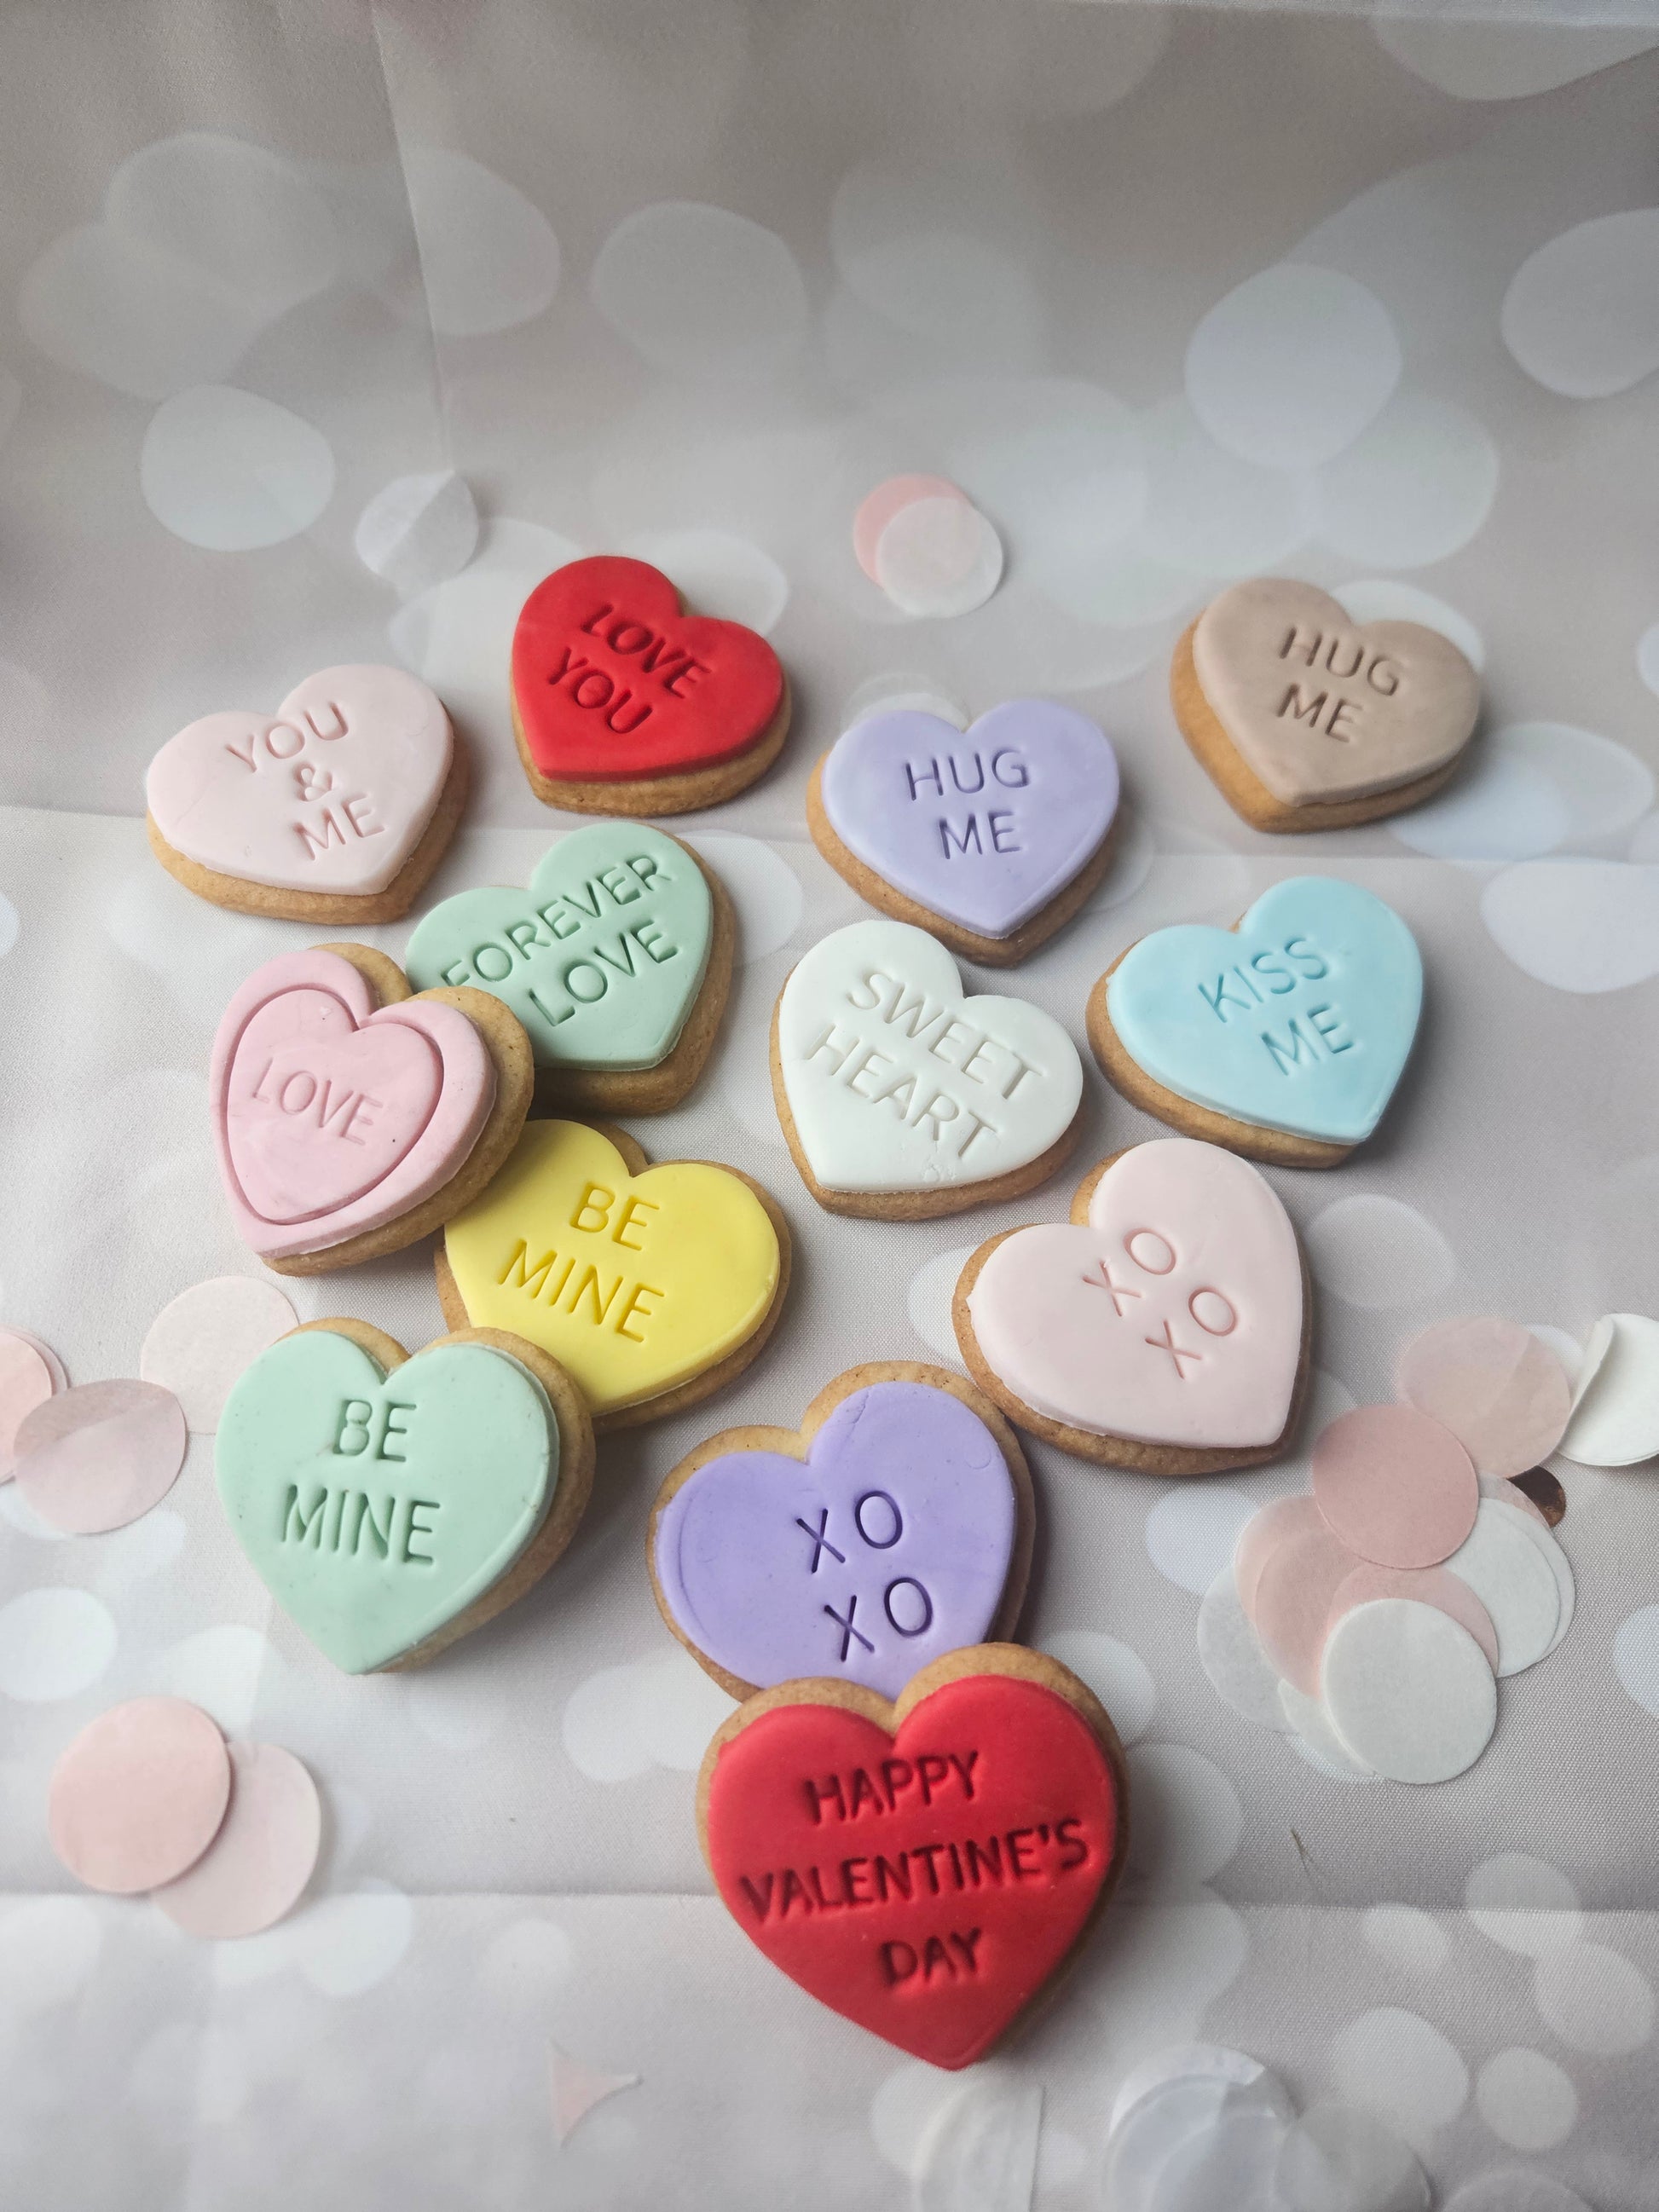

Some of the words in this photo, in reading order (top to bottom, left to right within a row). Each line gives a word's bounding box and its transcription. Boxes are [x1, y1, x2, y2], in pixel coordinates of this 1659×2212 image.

[581, 604, 711, 699] LOVE
[1279, 627, 1402, 697] HUG
[547, 648, 652, 735] YOU
[1276, 684, 1363, 744] ME
[225, 701, 350, 773] YOU
[905, 748, 1032, 801] HUG
[294, 761, 333, 803] &
[292, 792, 386, 861] ME
[938, 810, 1024, 859] ME
[528, 921, 679, 1027] LOVE
[1196, 937, 1332, 1023] KISS
[847, 970, 1046, 1102] SWEET
[1258, 1002, 1357, 1077] ME
[251, 1057, 384, 1146] LOVE
[806, 1025, 1003, 1158] HEART
[569, 1181, 661, 1251] BE
[498, 1239, 666, 1343] MINE
[332, 1398, 417, 1464] BE
[280, 1484, 442, 1567] MINE
[803, 1749, 980, 1826] HAPPY
[738, 1818, 1090, 1924] VALENTINE'S
[878, 1926, 983, 1987] DAY
